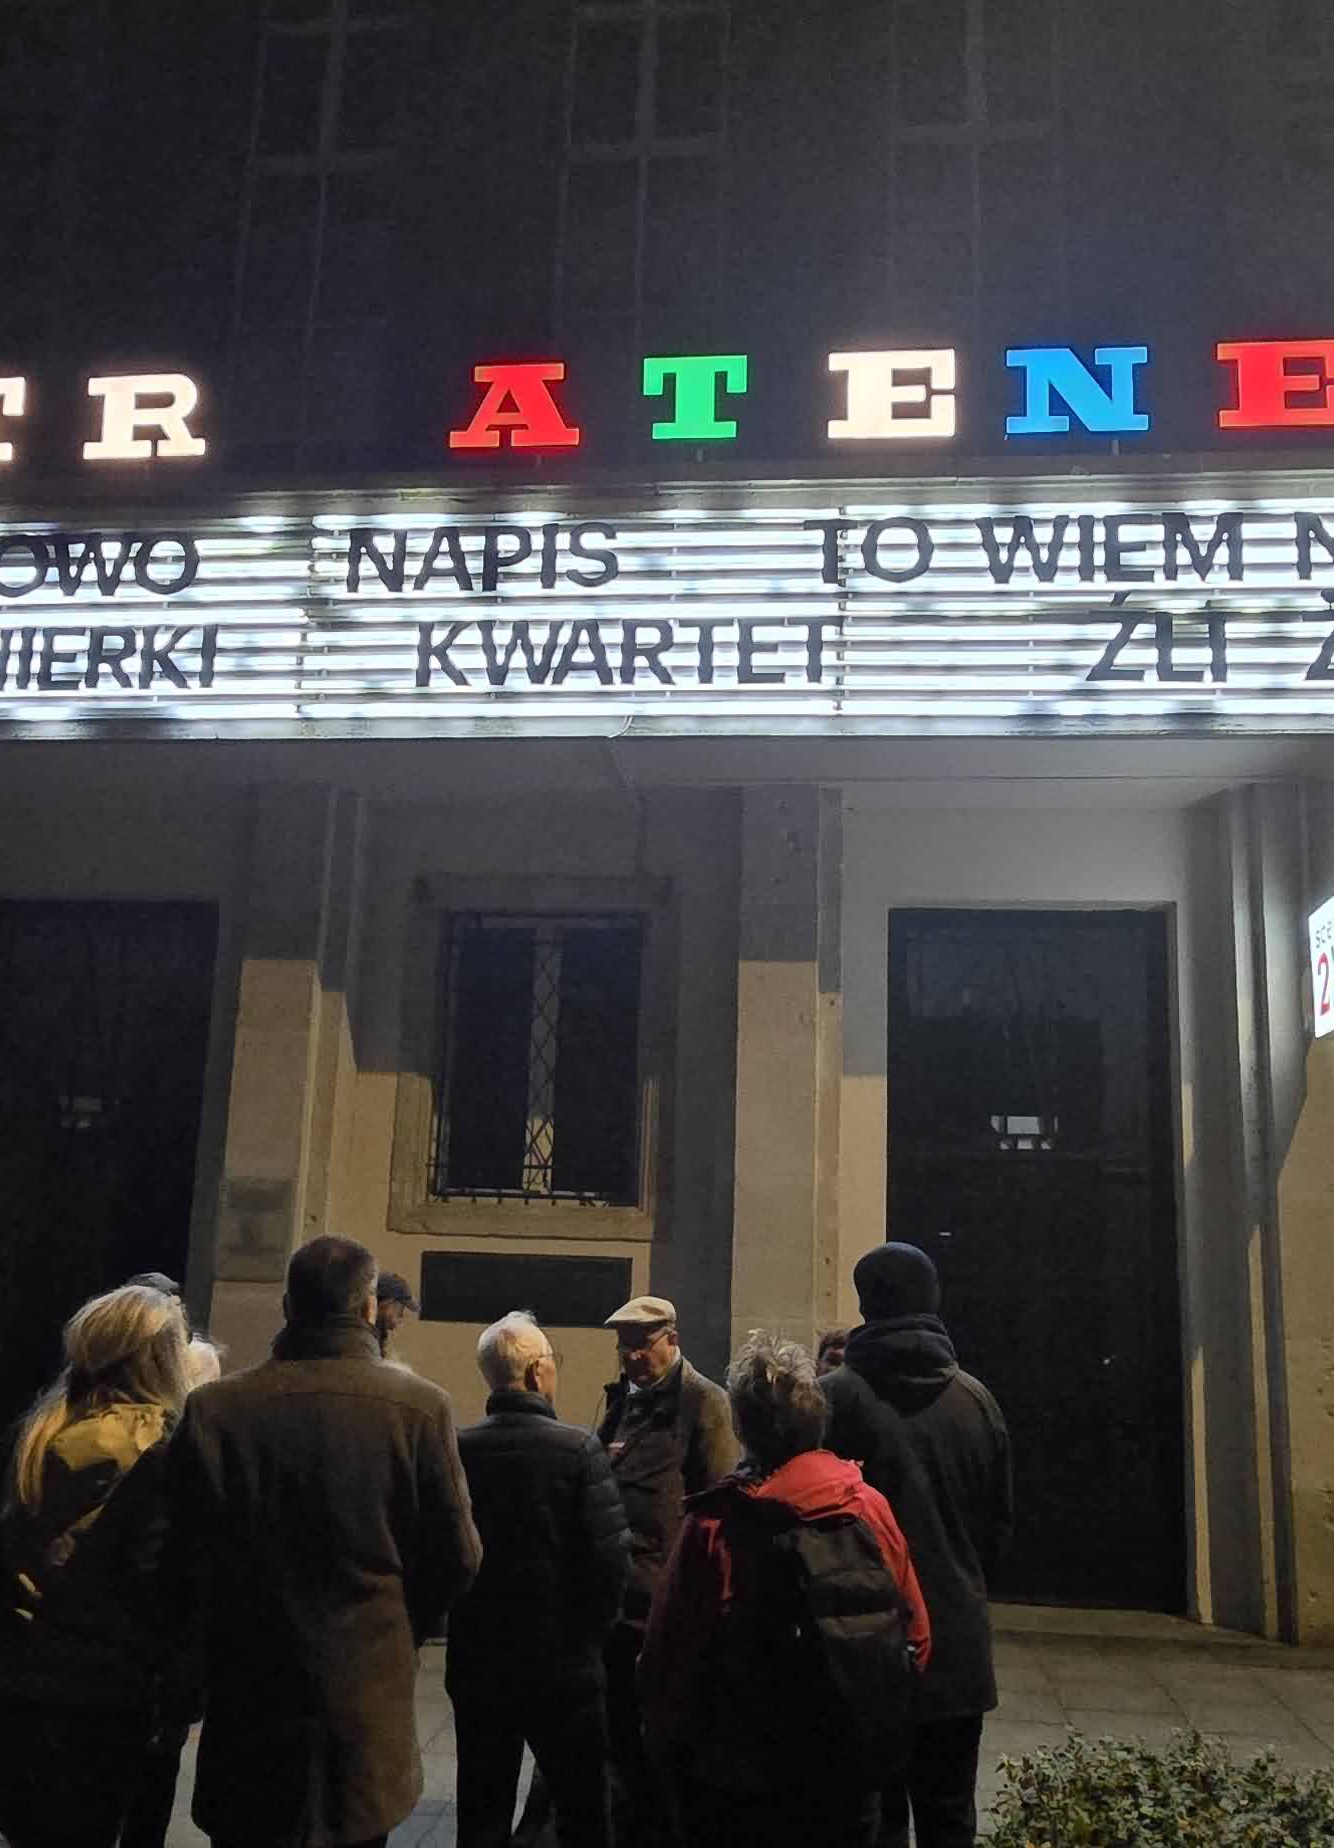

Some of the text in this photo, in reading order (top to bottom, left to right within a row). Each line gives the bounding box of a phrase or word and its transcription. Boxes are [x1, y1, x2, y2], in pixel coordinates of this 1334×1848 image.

[346, 521, 620, 593] NAPIS
[803, 516, 935, 586] TO
[976, 512, 1245, 584] WIEM
[414, 616, 845, 688] KWARTET
[1085, 590, 1228, 683] ŹLI
